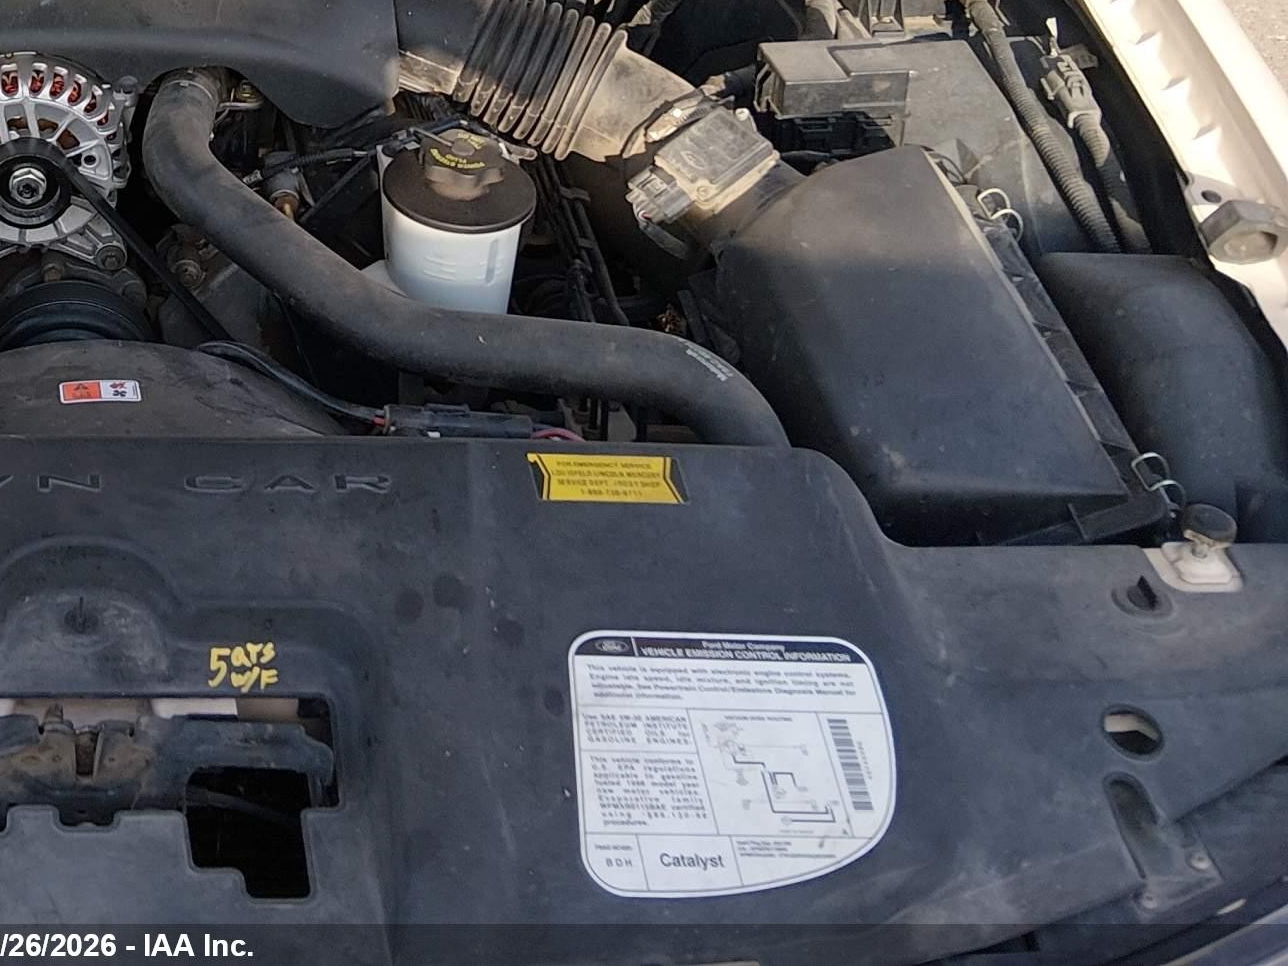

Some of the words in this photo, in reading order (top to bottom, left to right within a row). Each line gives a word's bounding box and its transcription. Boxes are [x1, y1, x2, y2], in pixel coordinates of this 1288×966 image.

[185, 474, 392, 493] CAR
[747, 643, 786, 653] Company
[641, 648, 683, 657] VEHICLE
[685, 649, 734, 658] EMISSION
[735, 651, 783, 660] CONTROL
[784, 652, 851, 662] INFORMATION
[208, 647, 231, 687] 5
[590, 673, 618, 681] Engine
[644, 722, 688, 730] INSTITUTE
[643, 765, 696, 773] regulations
[672, 795, 703, 803] family
[659, 853, 725, 870] Catalyst
